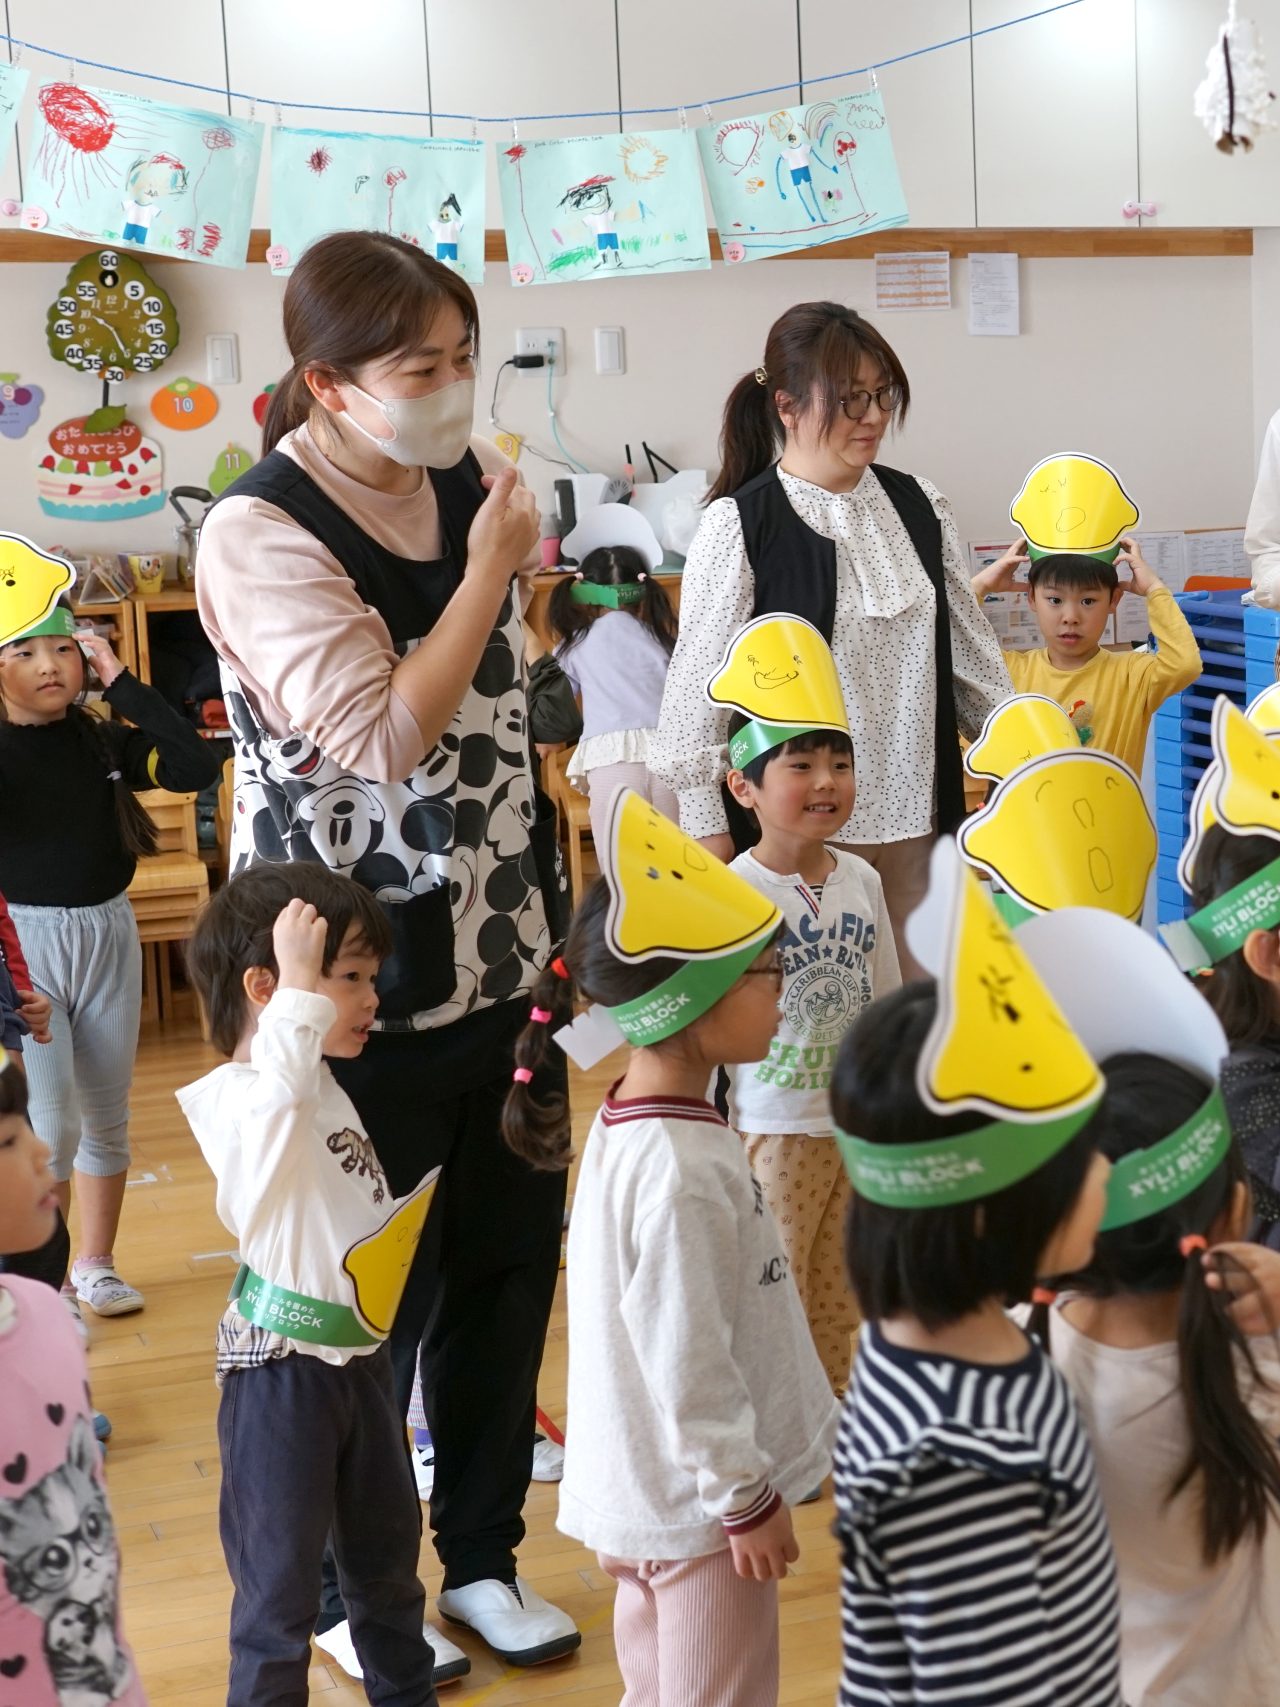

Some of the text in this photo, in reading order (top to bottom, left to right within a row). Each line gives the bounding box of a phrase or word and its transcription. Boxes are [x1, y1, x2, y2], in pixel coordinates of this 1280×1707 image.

[100, 255, 119, 267] 60
[78, 285, 97, 297] 55
[130, 285, 139, 297] 5
[91, 300, 101, 310] 11
[106, 295, 117, 305] 12
[58, 301, 77, 312] 50
[144, 301, 160, 313] 10
[55, 324, 75, 335] 45
[147, 323, 163, 335] 15
[67, 348, 84, 359] 40
[151, 344, 168, 355] 20
[84, 359, 103, 370] 35
[136, 356, 153, 368] 25
[107, 370, 124, 381] 30
[3, 385, 15, 400] 9
[173, 397, 194, 413] 10
[62, 442, 127, 455] おめでとう
[504, 437, 513, 453] 3
[225, 453, 241, 470] 11
[777, 912, 875, 953] ACIFIC
[783, 944, 821, 976] EAN
[790, 966, 842, 999] CARIBBEAN
[842, 974, 857, 992] CUP
[640, 992, 691, 1027] BLOCK
[897, 1158, 985, 1186] BLOCK
[1127, 1165, 1176, 1198] XYLI
[269, 1303, 324, 1328] BLOCK
